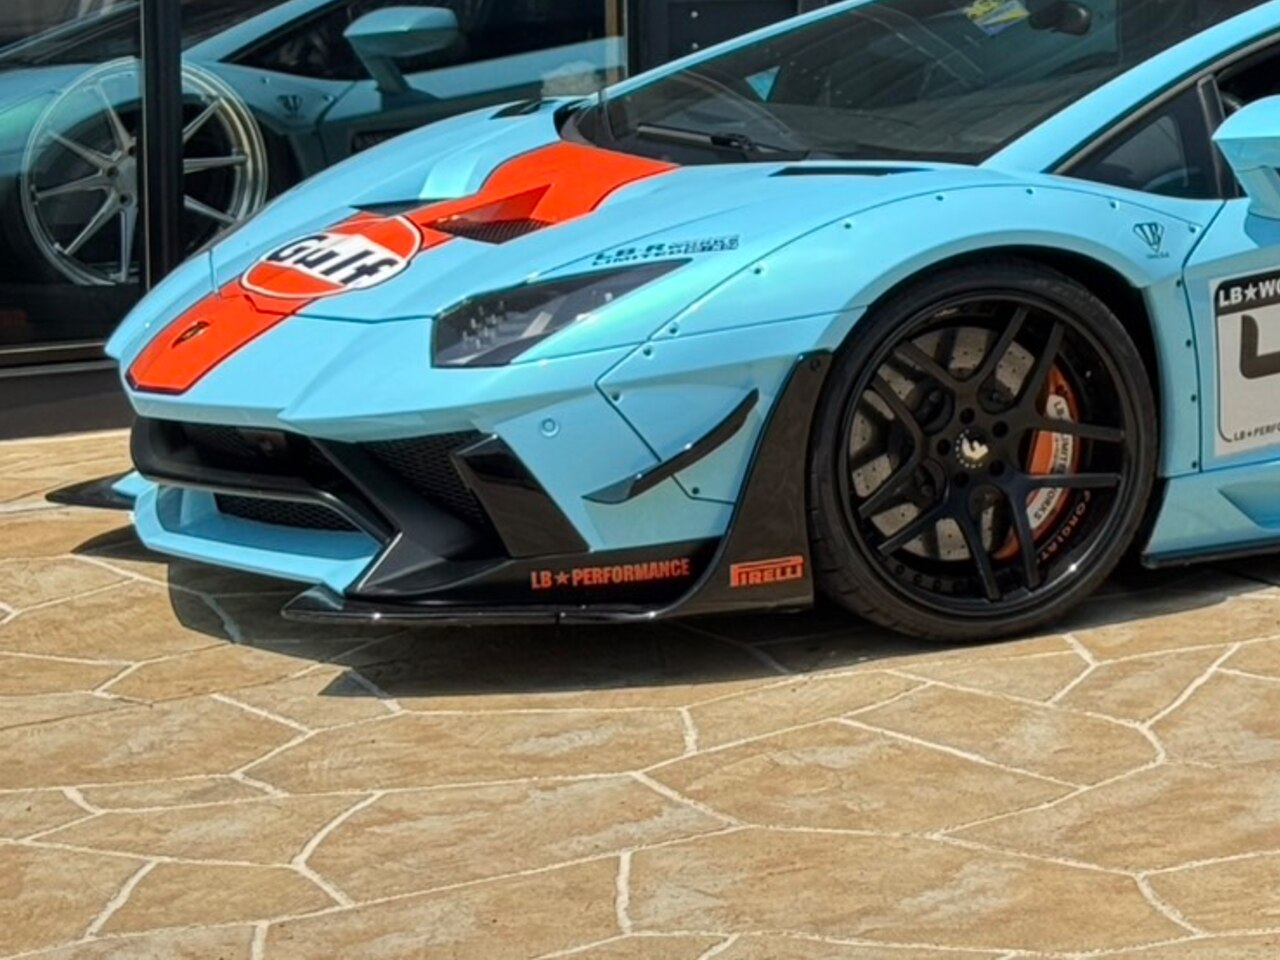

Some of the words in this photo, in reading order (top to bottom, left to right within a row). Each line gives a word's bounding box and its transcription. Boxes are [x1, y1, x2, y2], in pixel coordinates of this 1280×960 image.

[266, 235, 400, 286] Gulf
[572, 558, 690, 587] PERFORMANCE
[729, 555, 804, 588] PIRELLI
